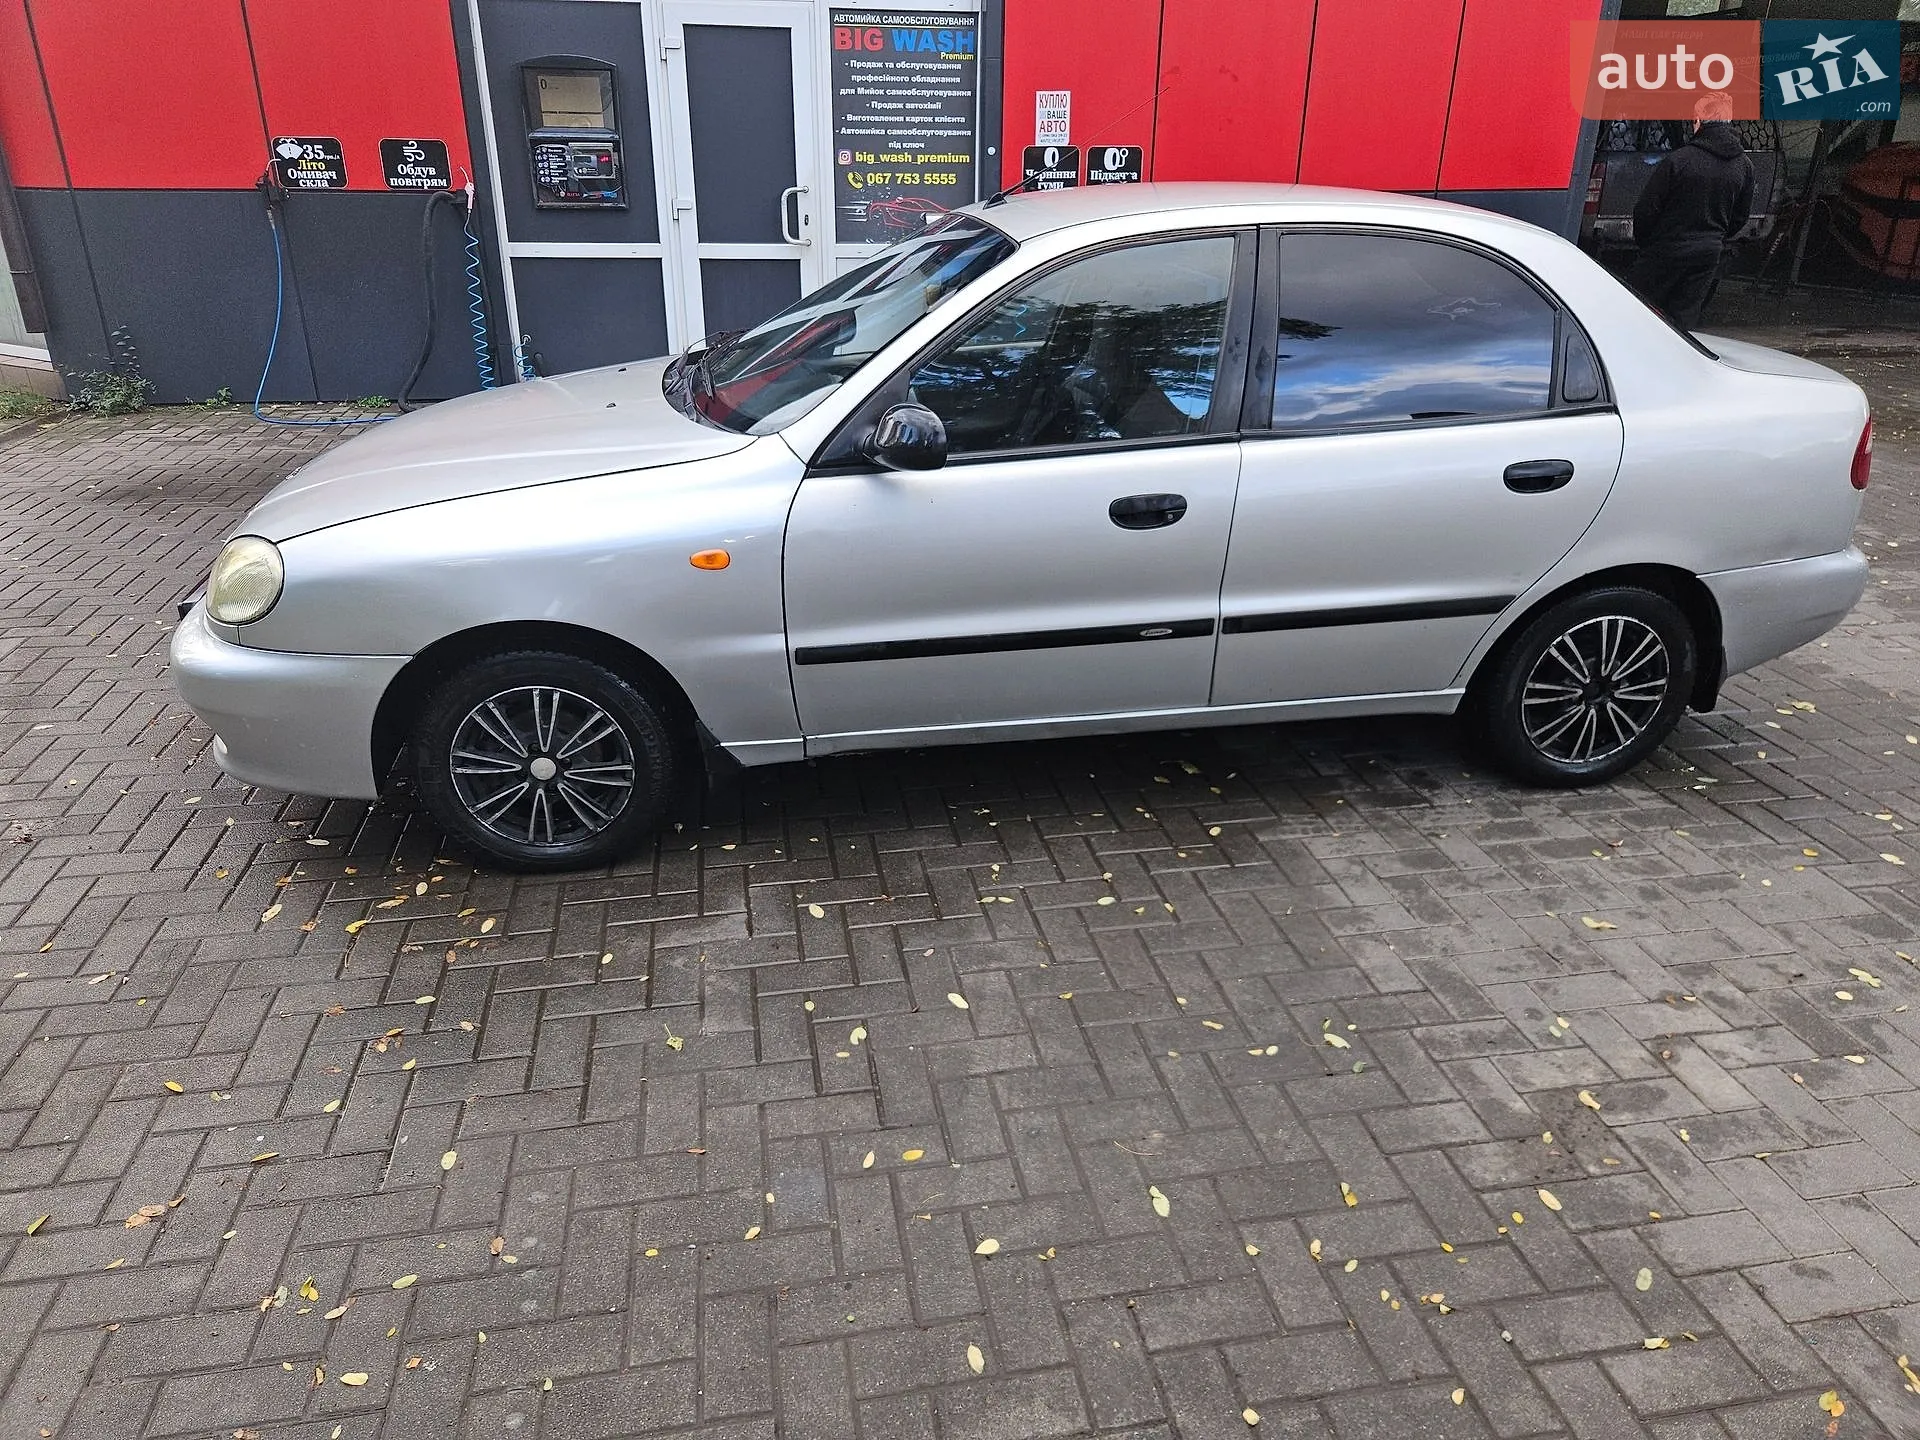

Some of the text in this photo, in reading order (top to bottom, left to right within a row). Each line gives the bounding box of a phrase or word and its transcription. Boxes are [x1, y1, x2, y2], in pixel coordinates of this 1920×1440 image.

[834, 13, 975, 26] АВТОМИЙКА САМООБСЛУГОВУВАННЯ
[834, 27, 975, 53] BIG WASH
[940, 52, 974, 61] Premium
[850, 60, 883, 69] Продаж
[896, 61, 962, 71] обслуговування
[851, 74, 961, 84] професійного обладнання
[839, 87, 972, 98] для Мийок самообслуговування
[871, 101, 904, 110] Продаж
[905, 102, 942, 110] автохімії
[1039, 93, 1068, 109] КУПЛЮ
[846, 114, 904, 122] Виготовлення
[905, 115, 933, 123] карток
[934, 115, 966, 123] клієнта
[1046, 110, 1067, 119] ВАШЕ
[840, 127, 886, 135] Автомийка
[887, 128, 972, 137] самообслуговування
[1039, 120, 1067, 133] АВТО
[888, 141, 902, 149] під
[302, 144, 325, 160] 35
[855, 151, 970, 164] big_wash_premium
[297, 159, 325, 170] Літо
[397, 163, 436, 177] Обдув
[287, 168, 337, 179] Омивач
[866, 172, 957, 185] 067 753 5555
[298, 178, 329, 187] скла
[389, 175, 448, 190] повітрям
